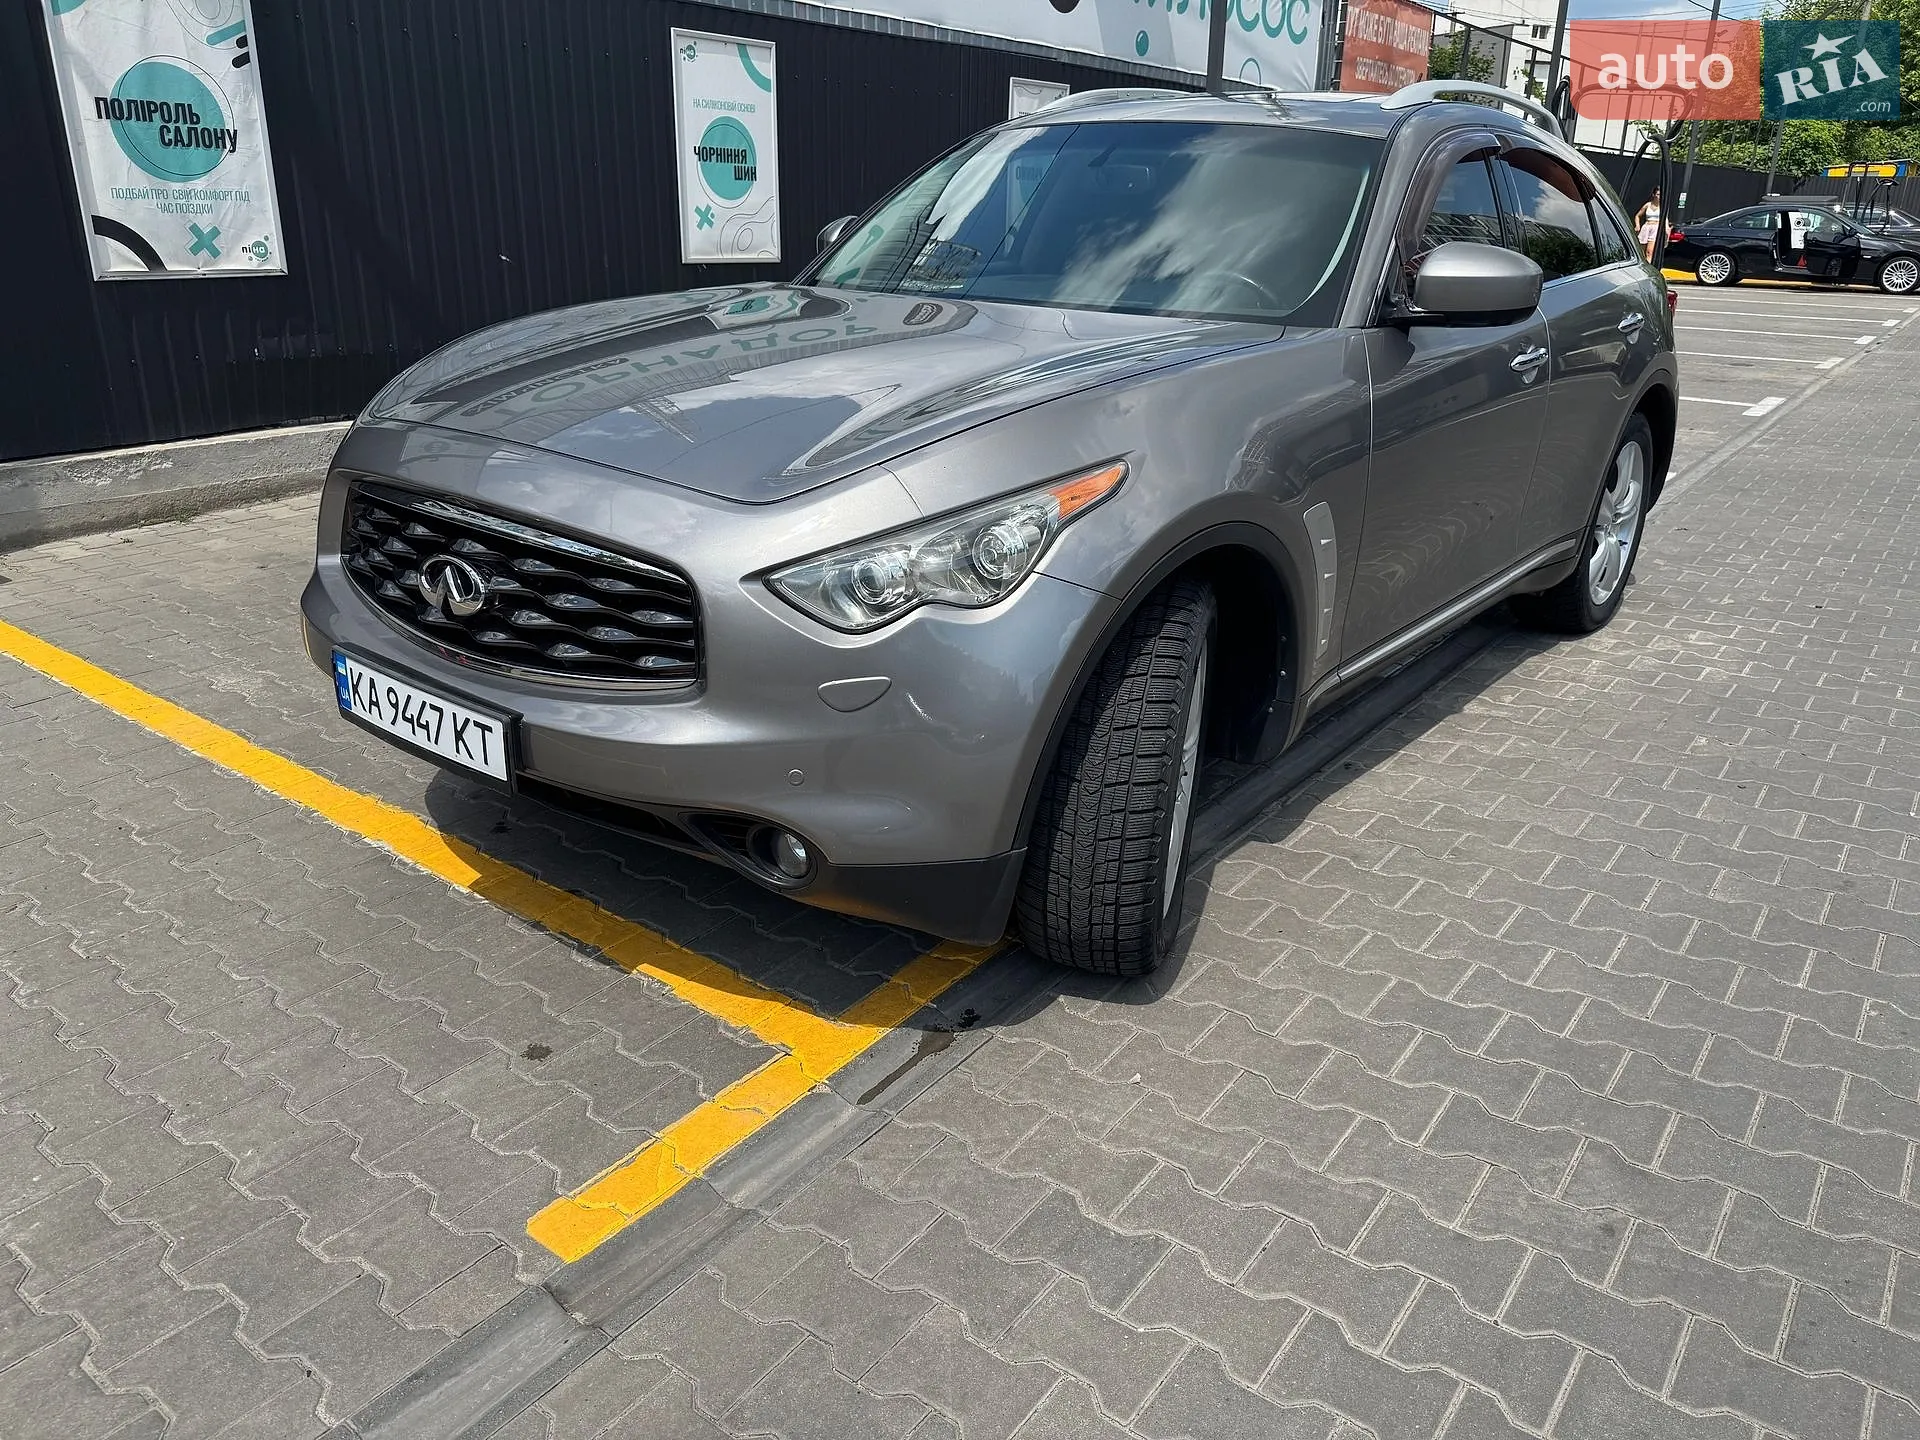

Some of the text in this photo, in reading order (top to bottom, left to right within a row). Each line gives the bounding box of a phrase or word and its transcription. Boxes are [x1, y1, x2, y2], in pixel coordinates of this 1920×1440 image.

[94, 96, 201, 125] ПОЛІРОЛЬ
[692, 98, 702, 109] НА
[159, 125, 238, 154] САЛОНУ
[693, 145, 748, 165] ЧОРНІННЯ
[733, 165, 757, 182] ШИН
[111, 186, 149, 201] ПОДБАЙ
[151, 188, 169, 200] ПРО
[193, 188, 234, 202] КОМФОРТ
[235, 189, 251, 203] ПІД
[156, 200, 214, 215] ЧАС ПОЇЗДКИ
[340, 686, 351, 701] UA
[349, 666, 493, 766] KA 9447 KT
